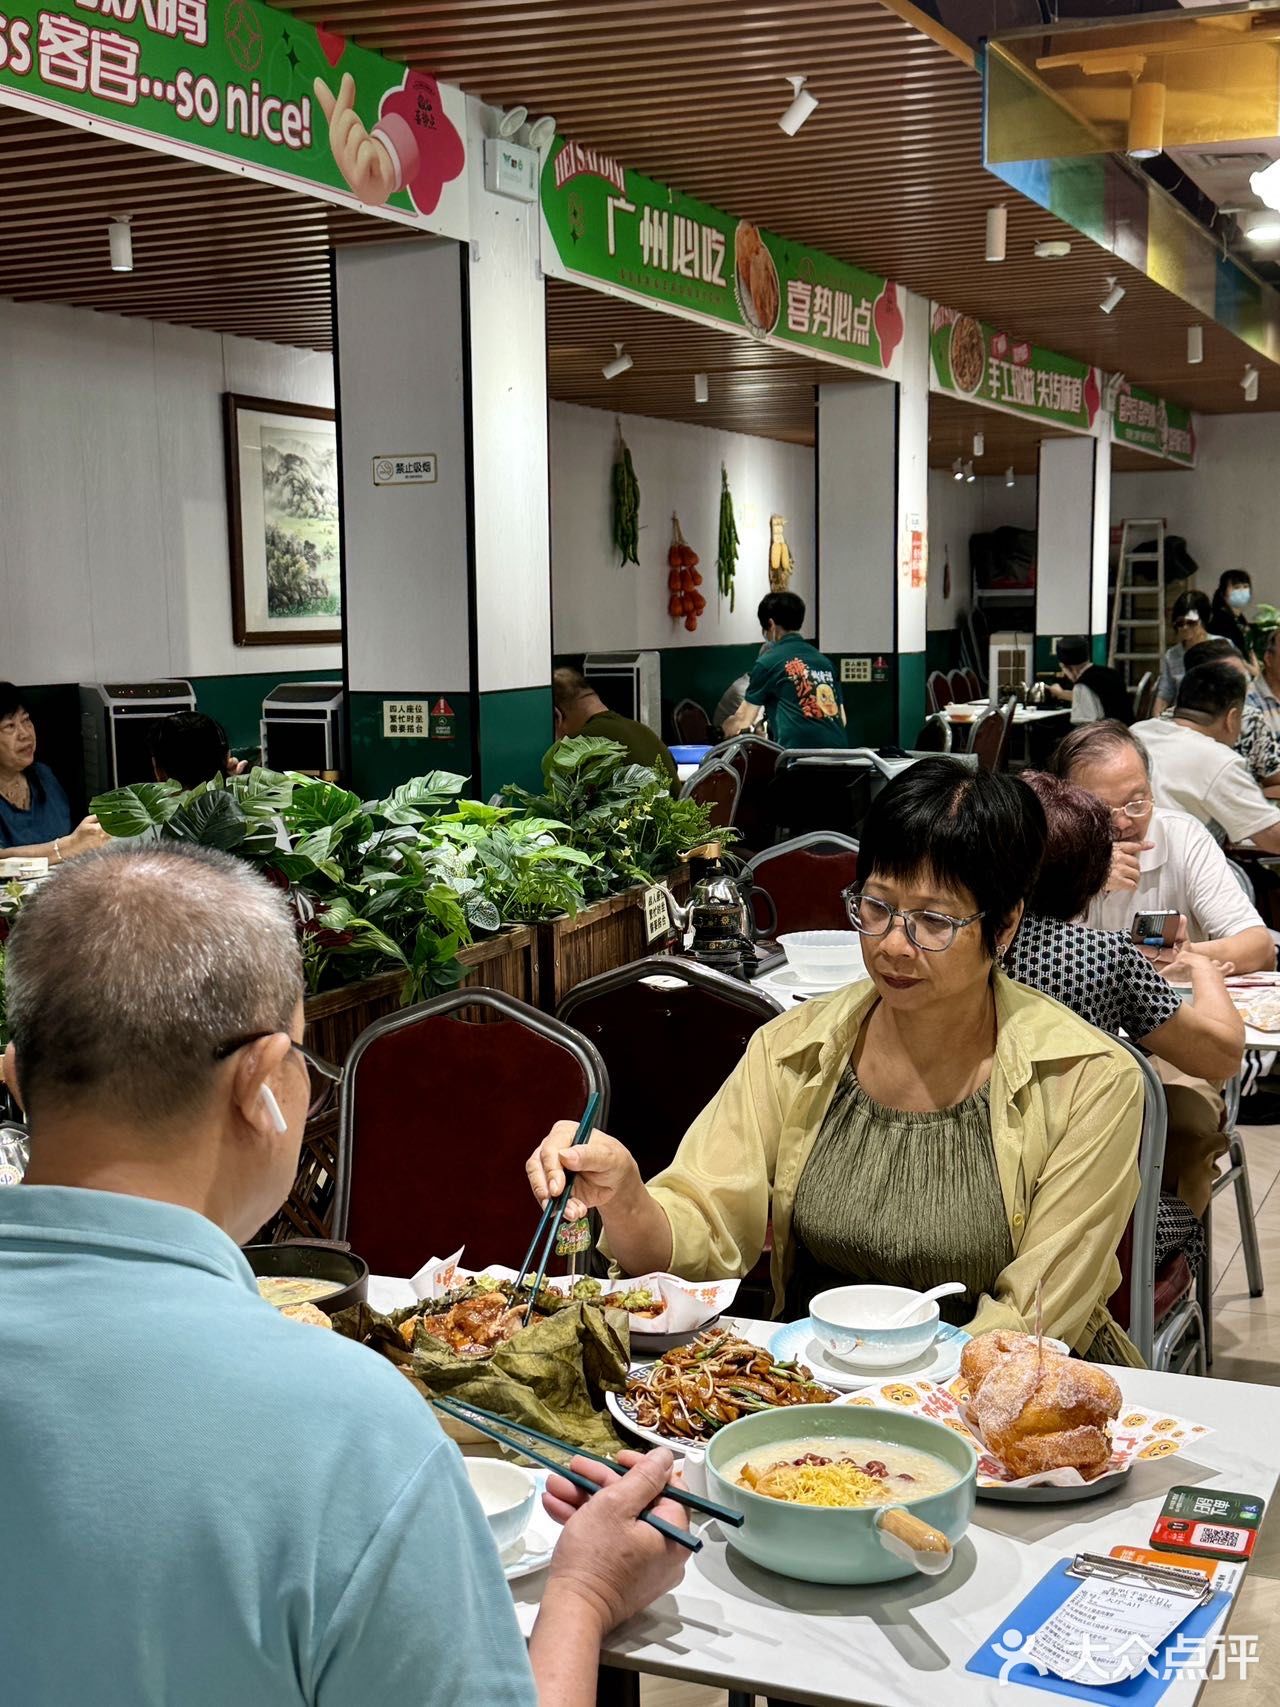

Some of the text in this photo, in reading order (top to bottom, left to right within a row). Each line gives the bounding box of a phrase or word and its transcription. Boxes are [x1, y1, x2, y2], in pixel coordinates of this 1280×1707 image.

[227, 81, 311, 148] nice!
[607, 195, 728, 288] 广州必吃
[787, 280, 873, 346] 喜势必点
[396, 461, 432, 474] 禁止吸烟
